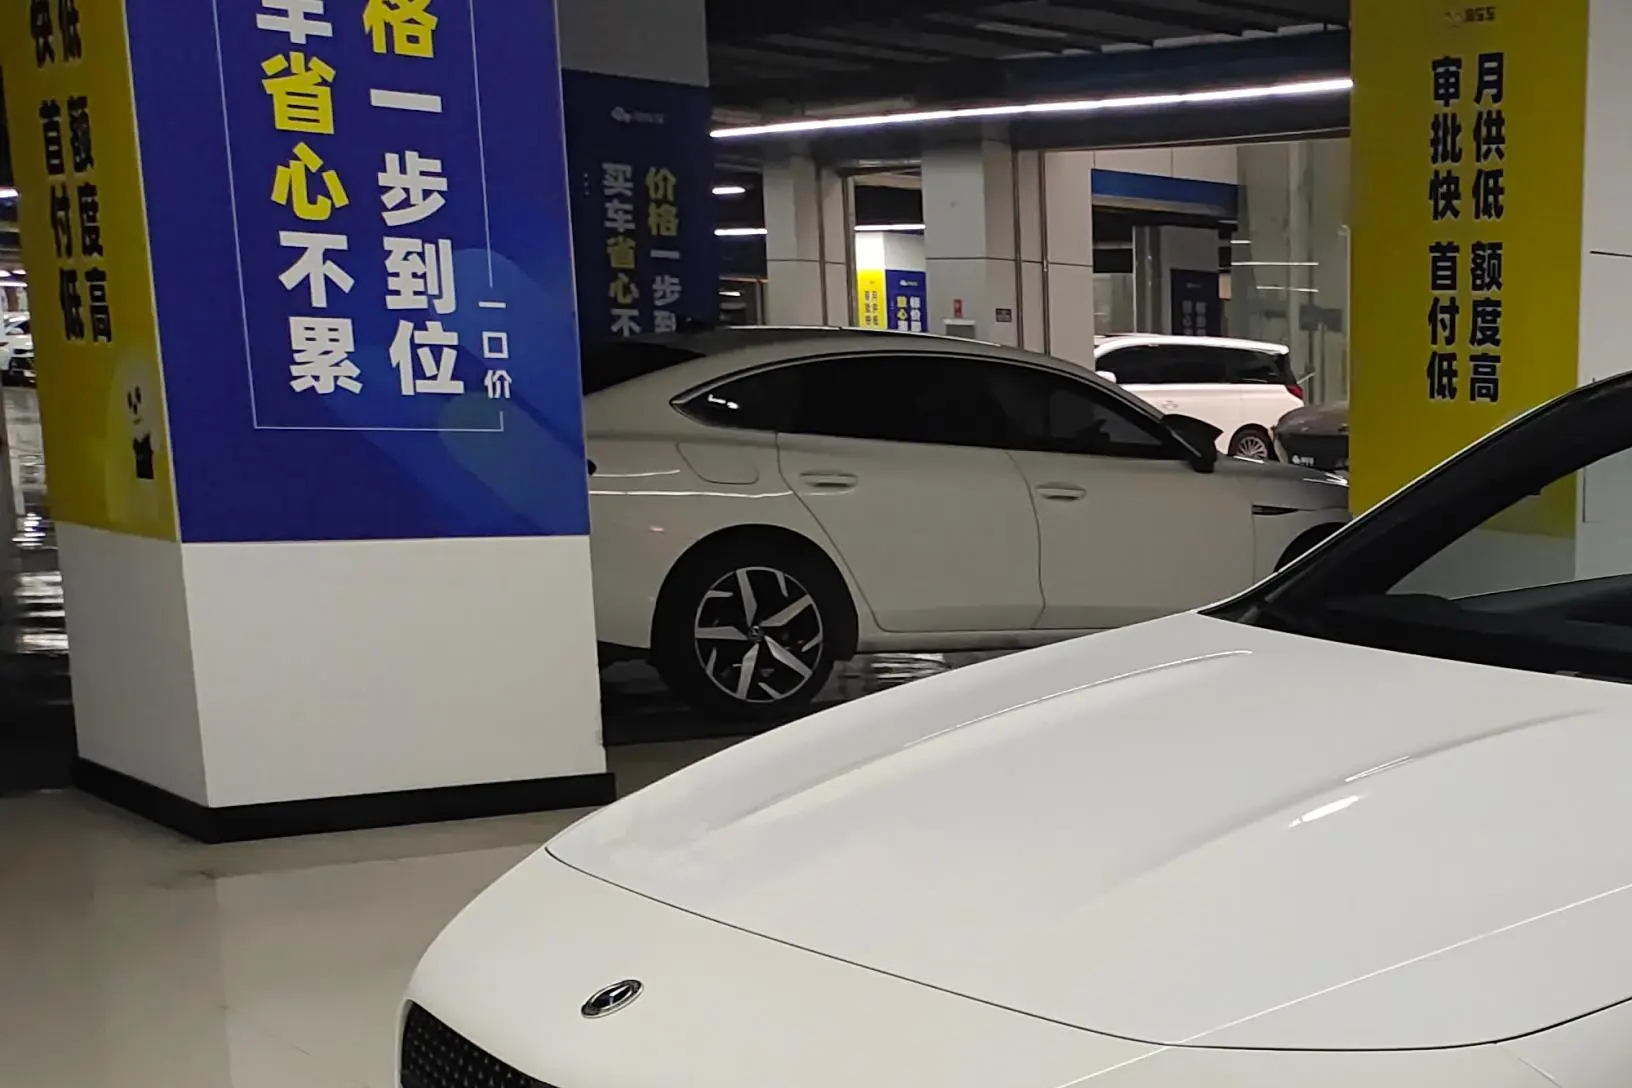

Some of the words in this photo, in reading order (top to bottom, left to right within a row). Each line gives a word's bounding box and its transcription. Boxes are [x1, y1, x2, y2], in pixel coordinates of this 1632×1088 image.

[38, 99, 85, 341] 首付低
[67, 96, 112, 342] 额度高
[363, 0, 466, 396] 格一步到位
[1428, 56, 1463, 221] 审批快
[1472, 52, 1506, 220] 月供低
[602, 162, 642, 338] 买车省心不
[1426, 241, 1461, 400] 首付低
[1469, 241, 1504, 403] 额度高
[478, 301, 512, 399] 一口价
